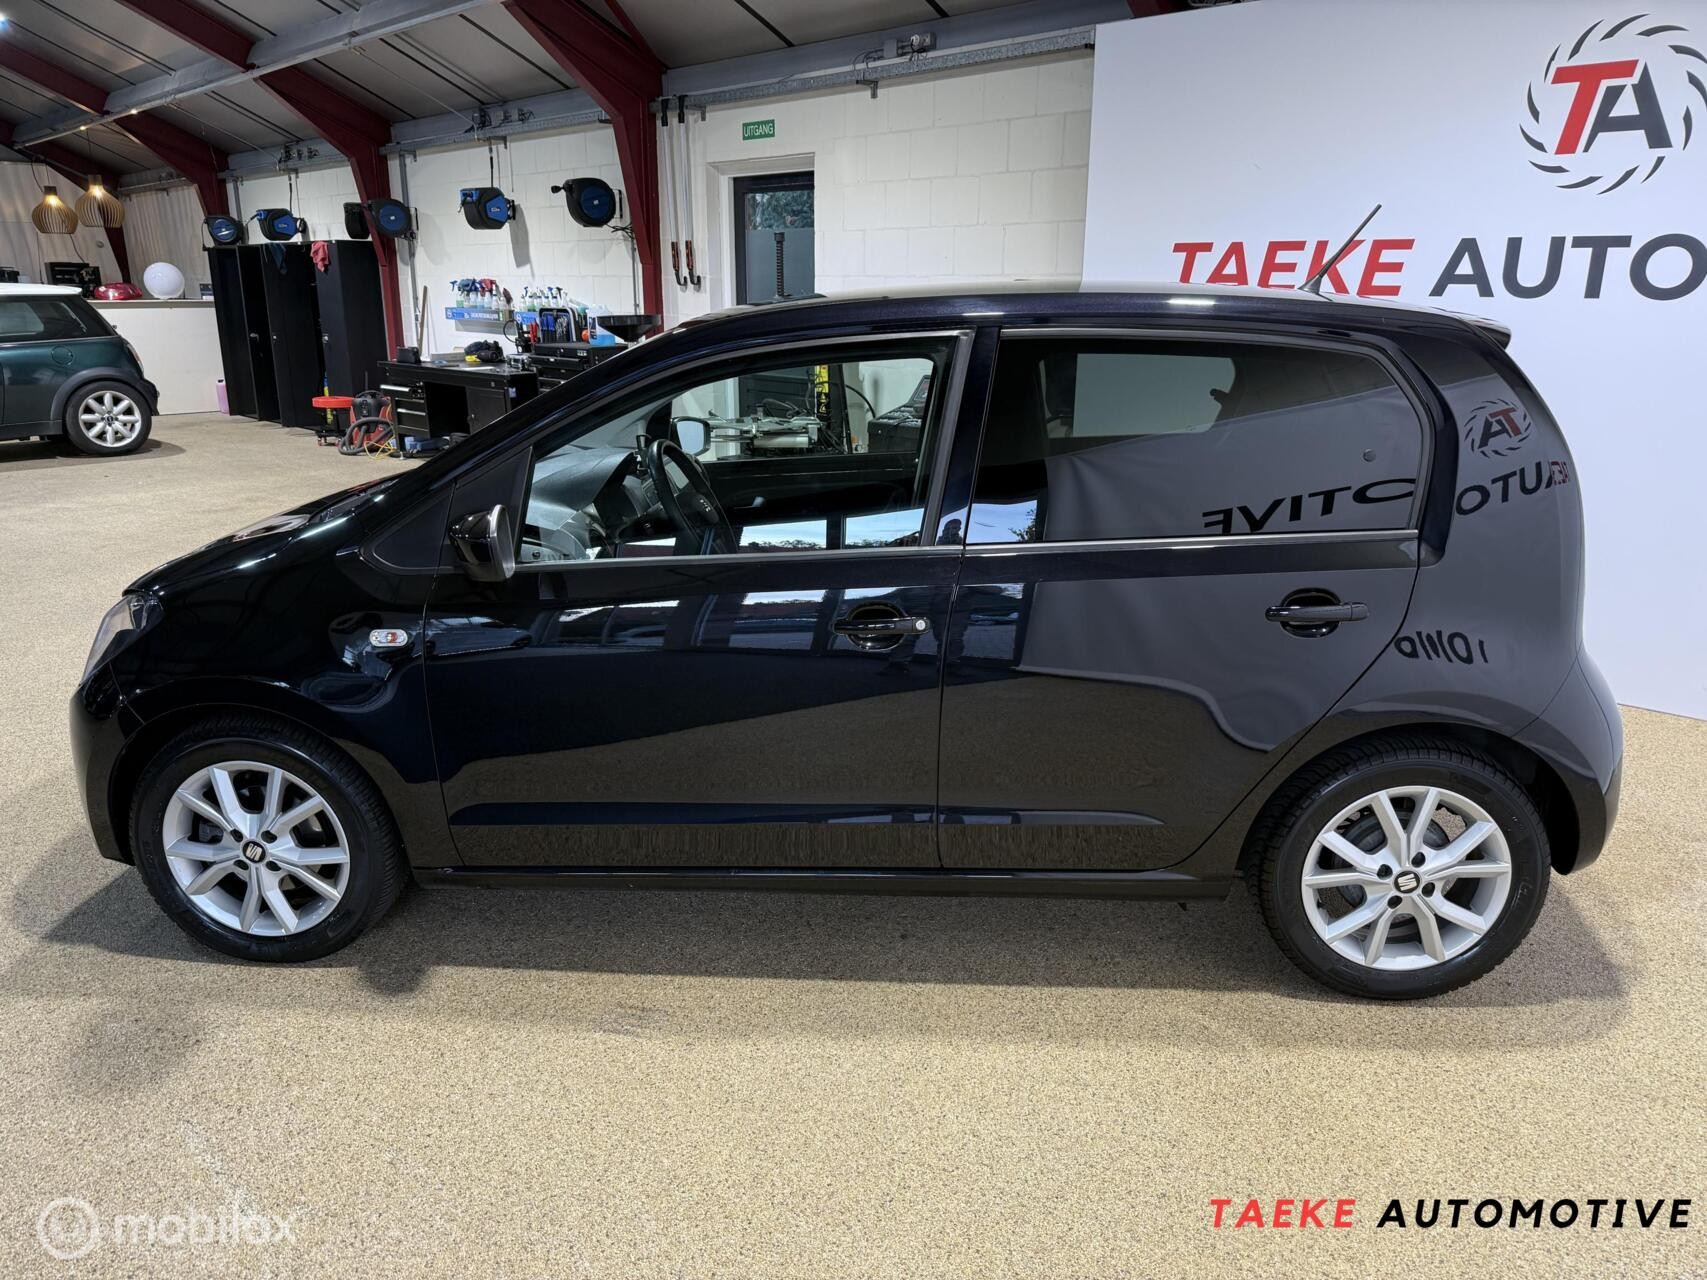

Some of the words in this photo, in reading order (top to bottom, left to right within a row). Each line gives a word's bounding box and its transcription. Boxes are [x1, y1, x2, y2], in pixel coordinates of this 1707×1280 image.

[743, 123, 774, 137] UITGANG
[1551, 59, 1673, 155] TA
[1172, 239, 1415, 297] TAEKE
[1428, 233, 1707, 301] AUTO
